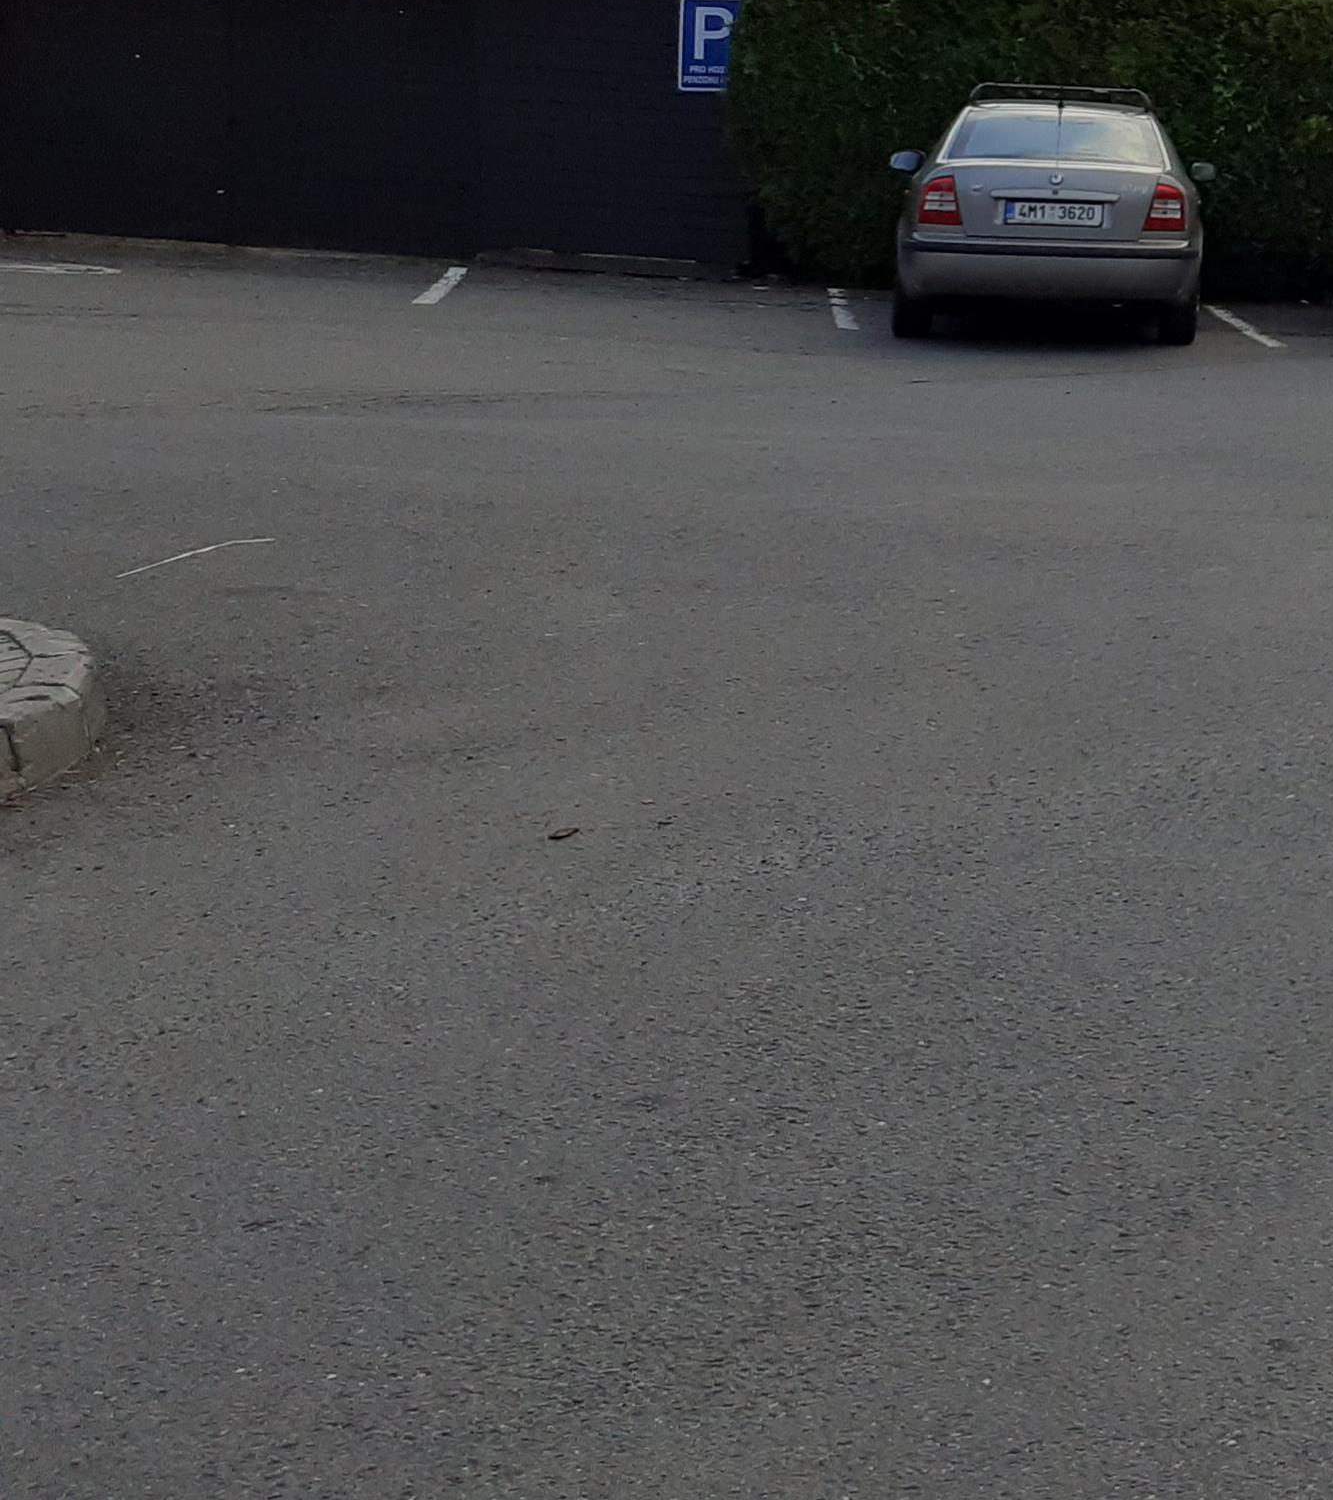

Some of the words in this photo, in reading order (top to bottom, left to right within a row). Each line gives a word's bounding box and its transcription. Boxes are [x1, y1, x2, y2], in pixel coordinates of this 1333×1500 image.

[693, 6, 735, 60] P
[1018, 204, 1046, 219] 4M1
[1058, 206, 1096, 221] 3620
